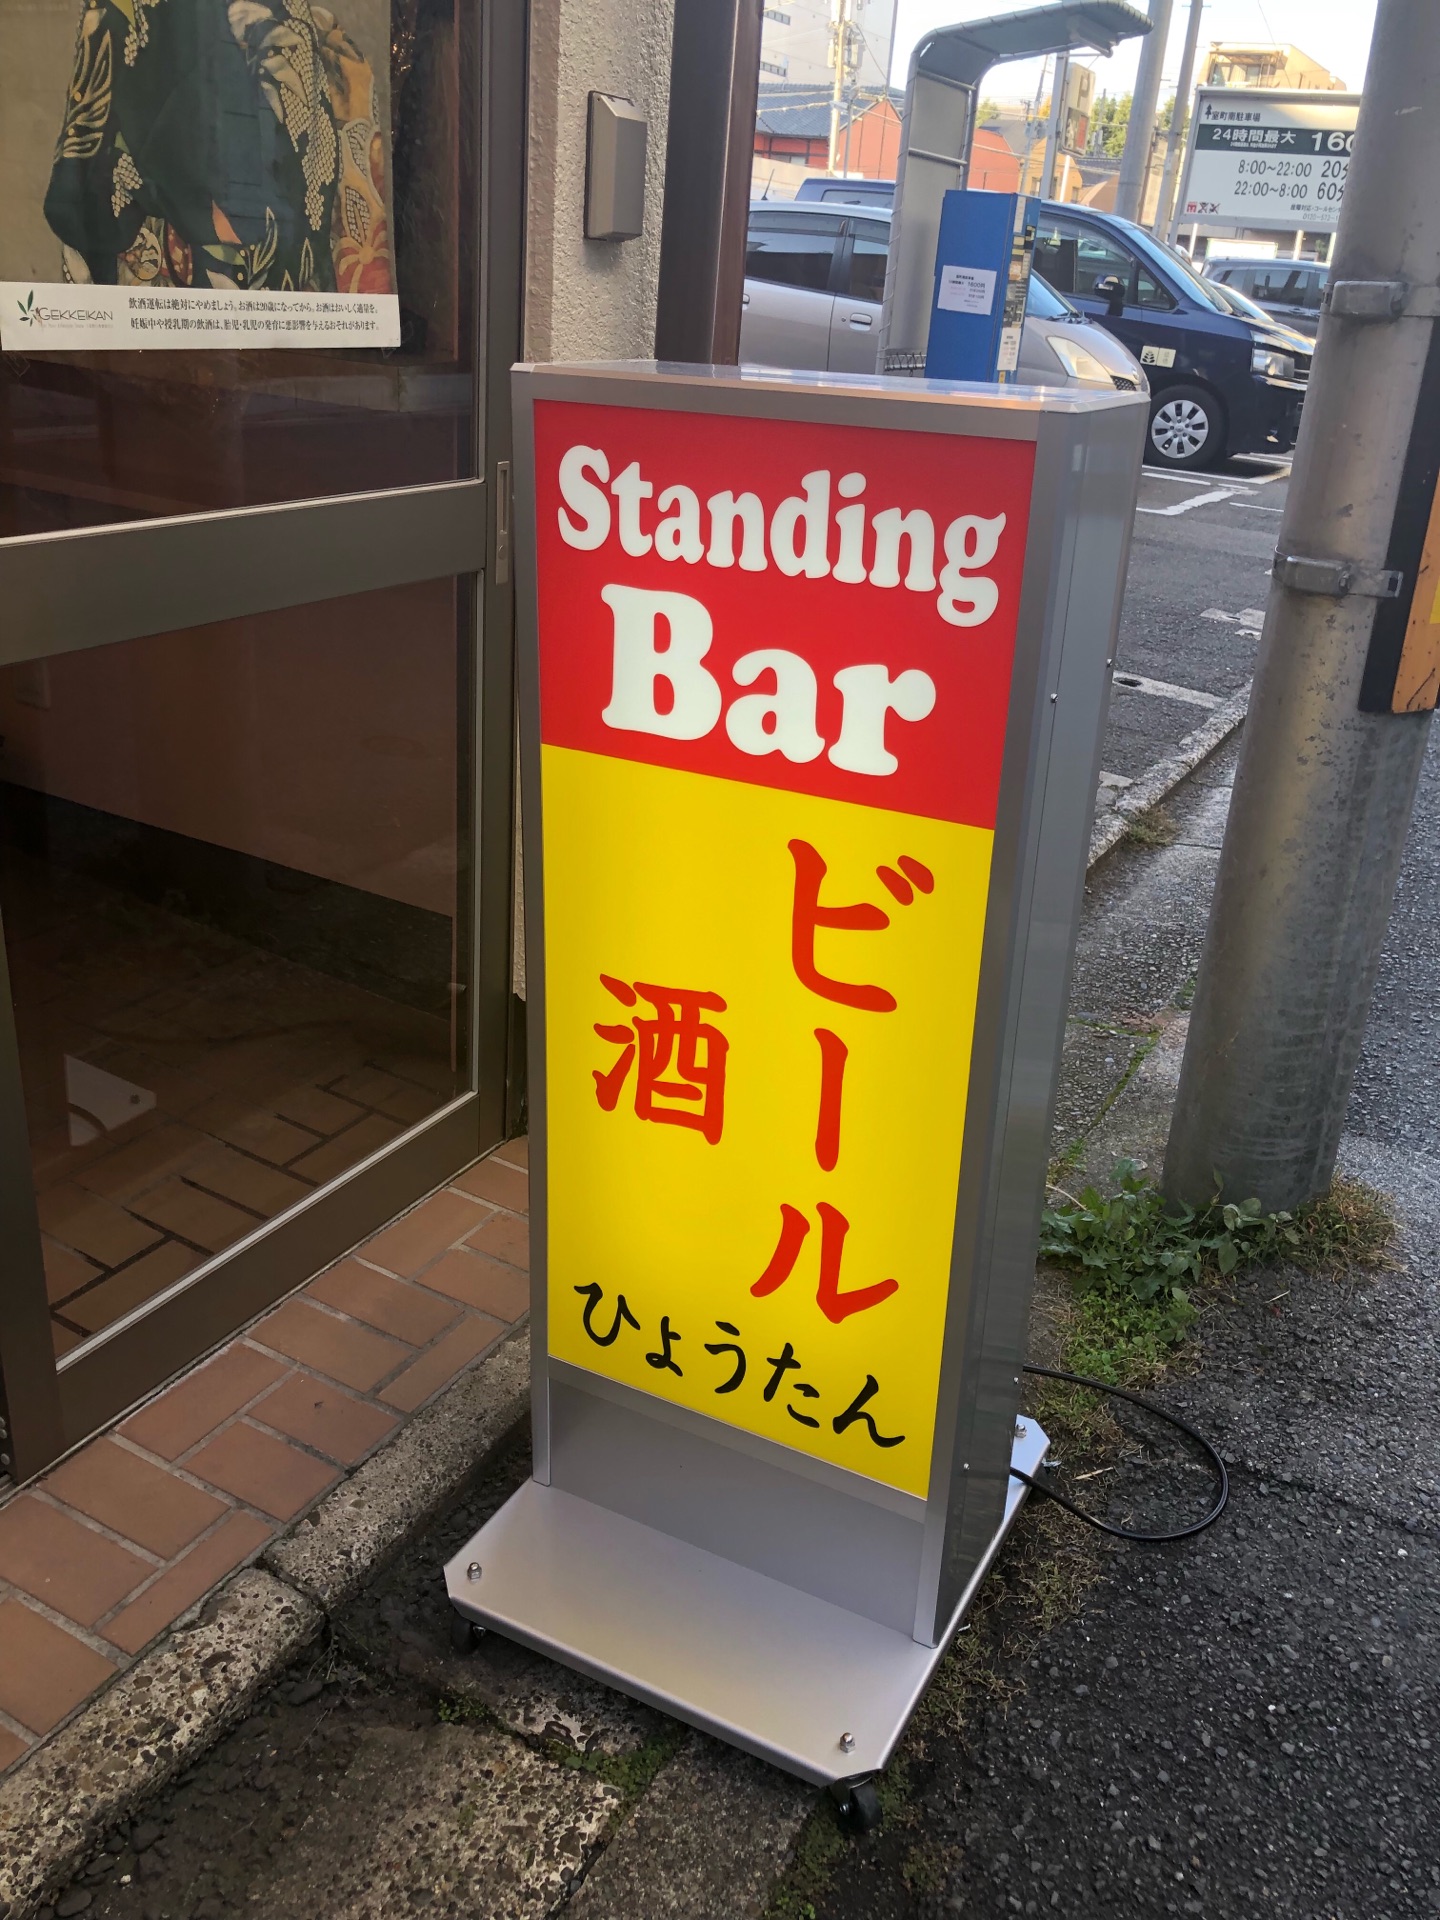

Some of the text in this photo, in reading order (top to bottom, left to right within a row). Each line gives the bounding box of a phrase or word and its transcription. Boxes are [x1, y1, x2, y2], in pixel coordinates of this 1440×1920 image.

[1212, 128, 1297, 144] 24時間最大
[39, 307, 114, 321] GEKKEIKAN
[557, 445, 1007, 628] Standing
[600, 583, 937, 776] Bar
[591, 973, 730, 1146] 酒
[750, 838, 935, 1324] ビール
[573, 1282, 906, 1448] ひょうたん
